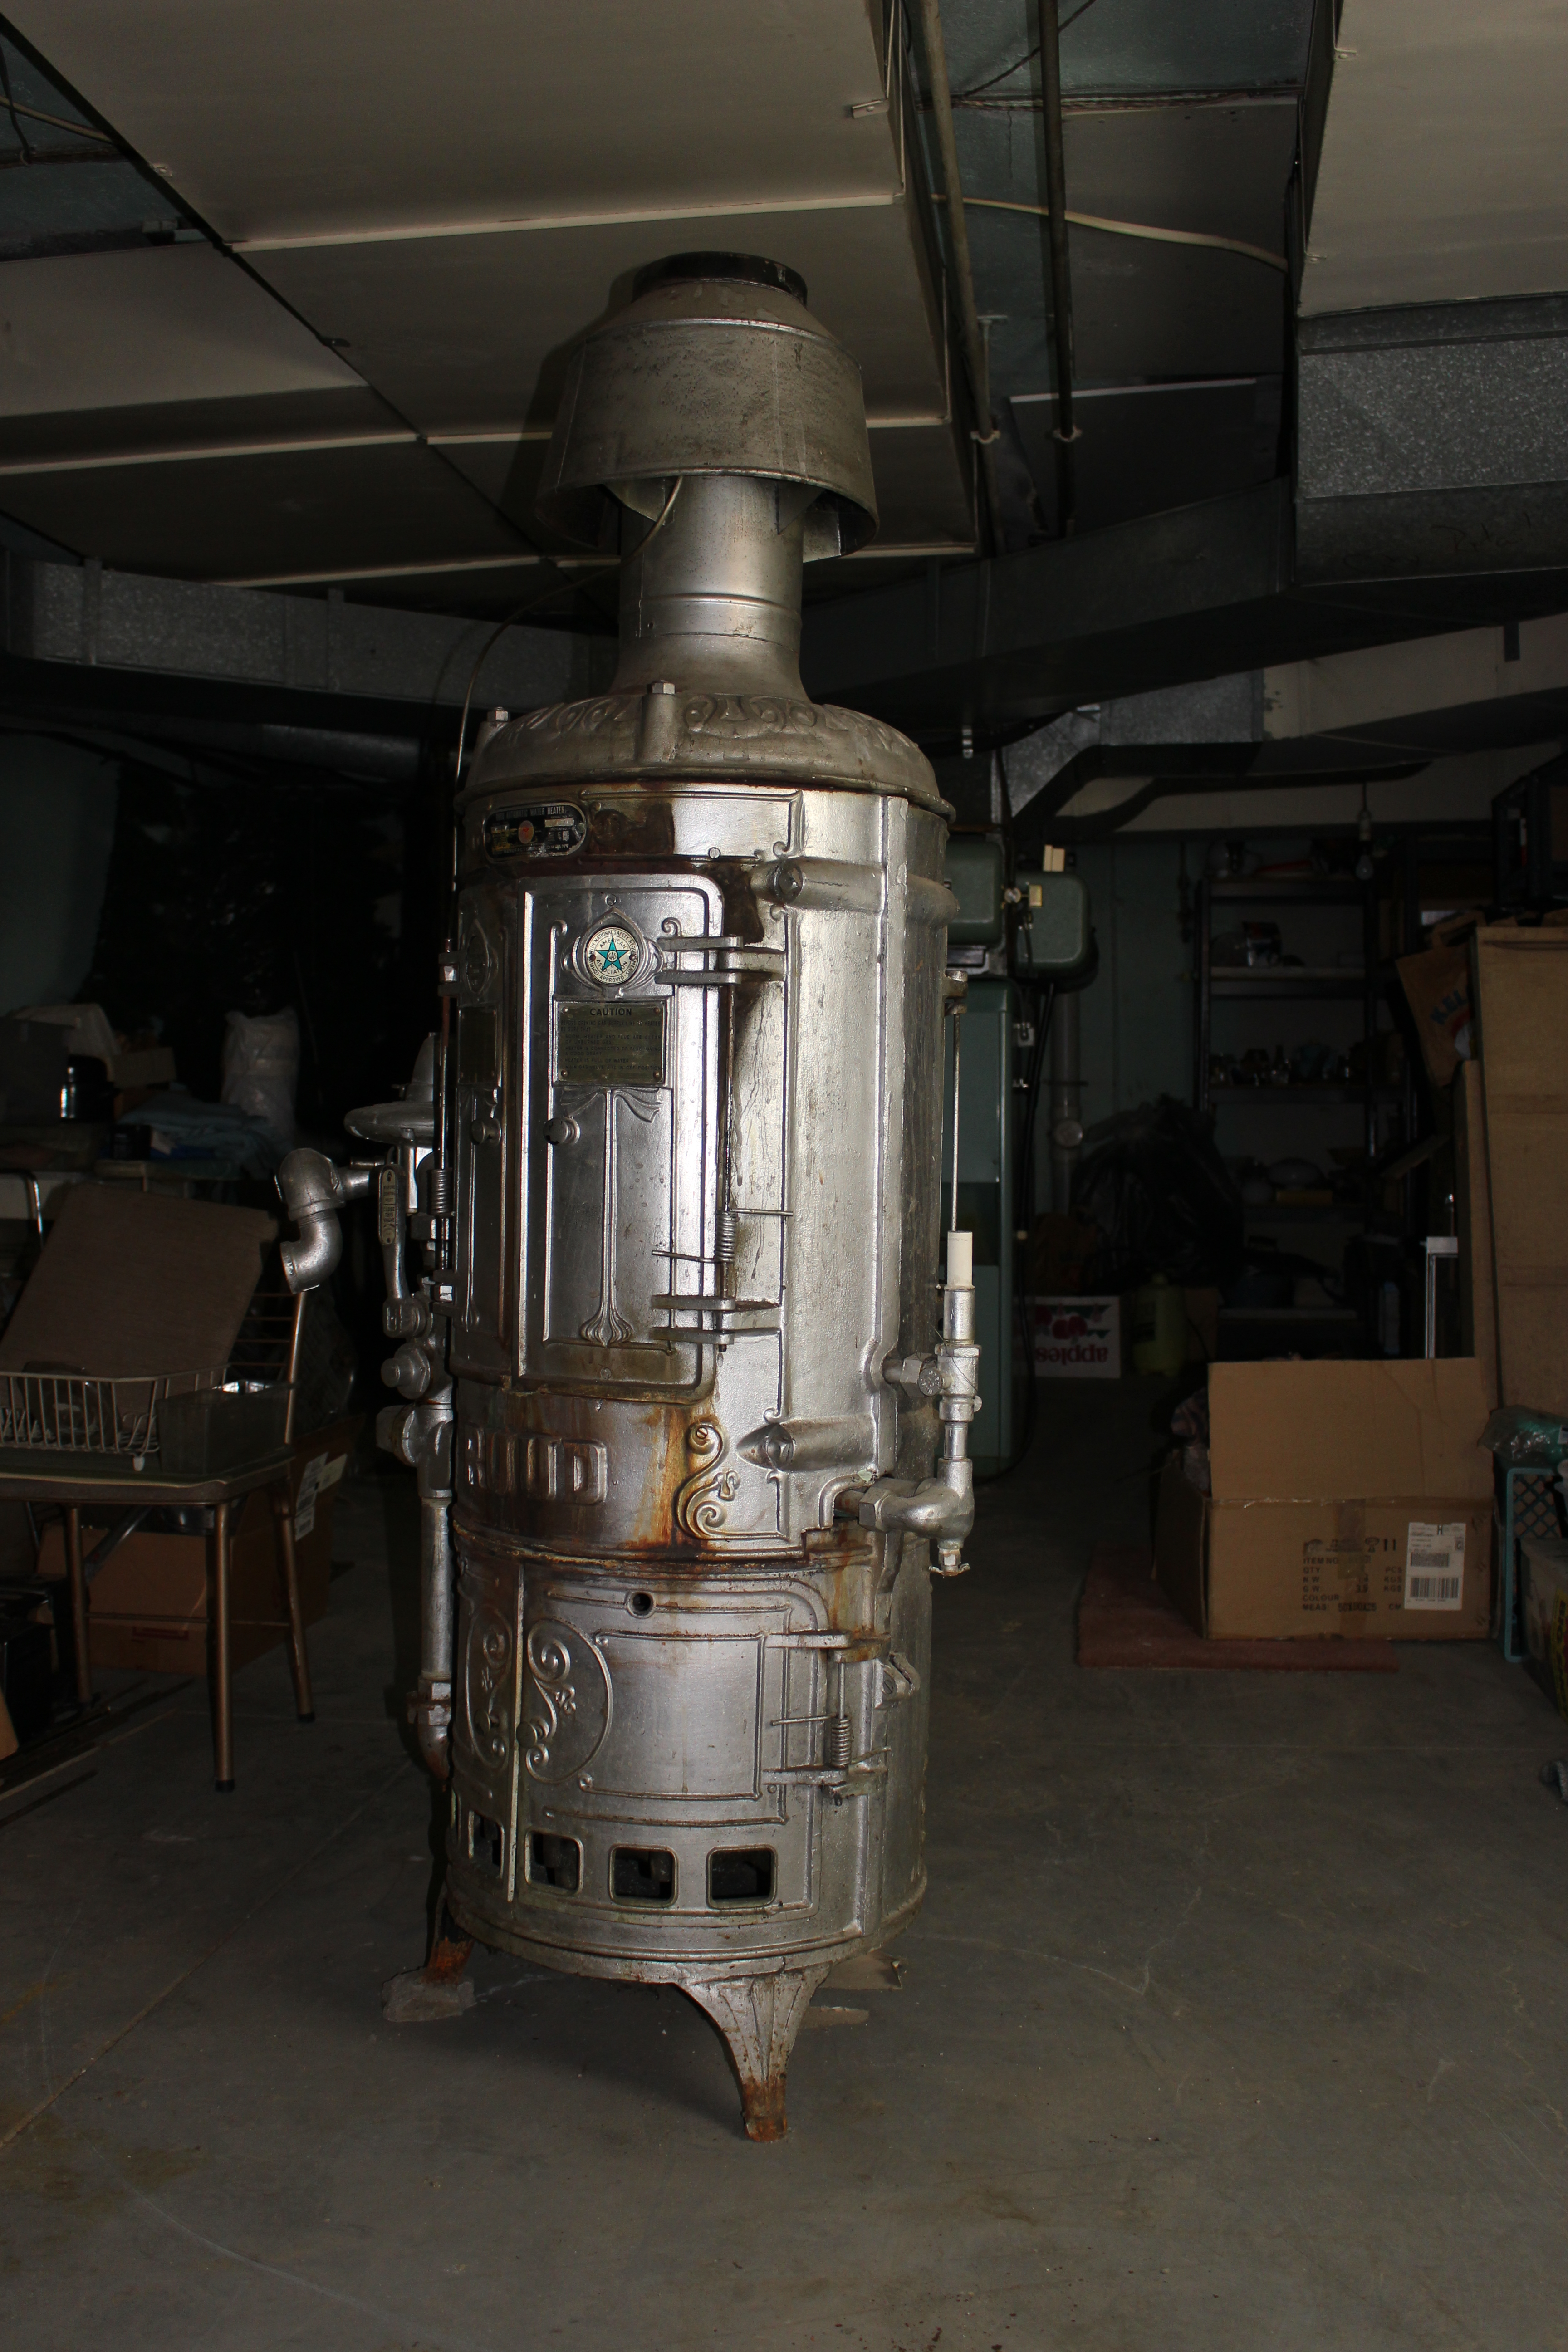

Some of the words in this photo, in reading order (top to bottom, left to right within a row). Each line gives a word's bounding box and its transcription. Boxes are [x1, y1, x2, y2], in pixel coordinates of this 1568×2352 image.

[530, 808, 545, 816] WATER
[547, 806, 564, 815] HEATER
[594, 930, 612, 943] NATIONAL
[613, 930, 629, 940] SAFETY
[599, 938, 627, 949] AMERICAN
[608, 952, 617, 960] GAS
[596, 960, 628, 975] ASSOCIATION
[590, 1008, 632, 1016] CAUTION
[1034, 1344, 1109, 1366] apples
[461, 1423, 608, 1505] RUUD
